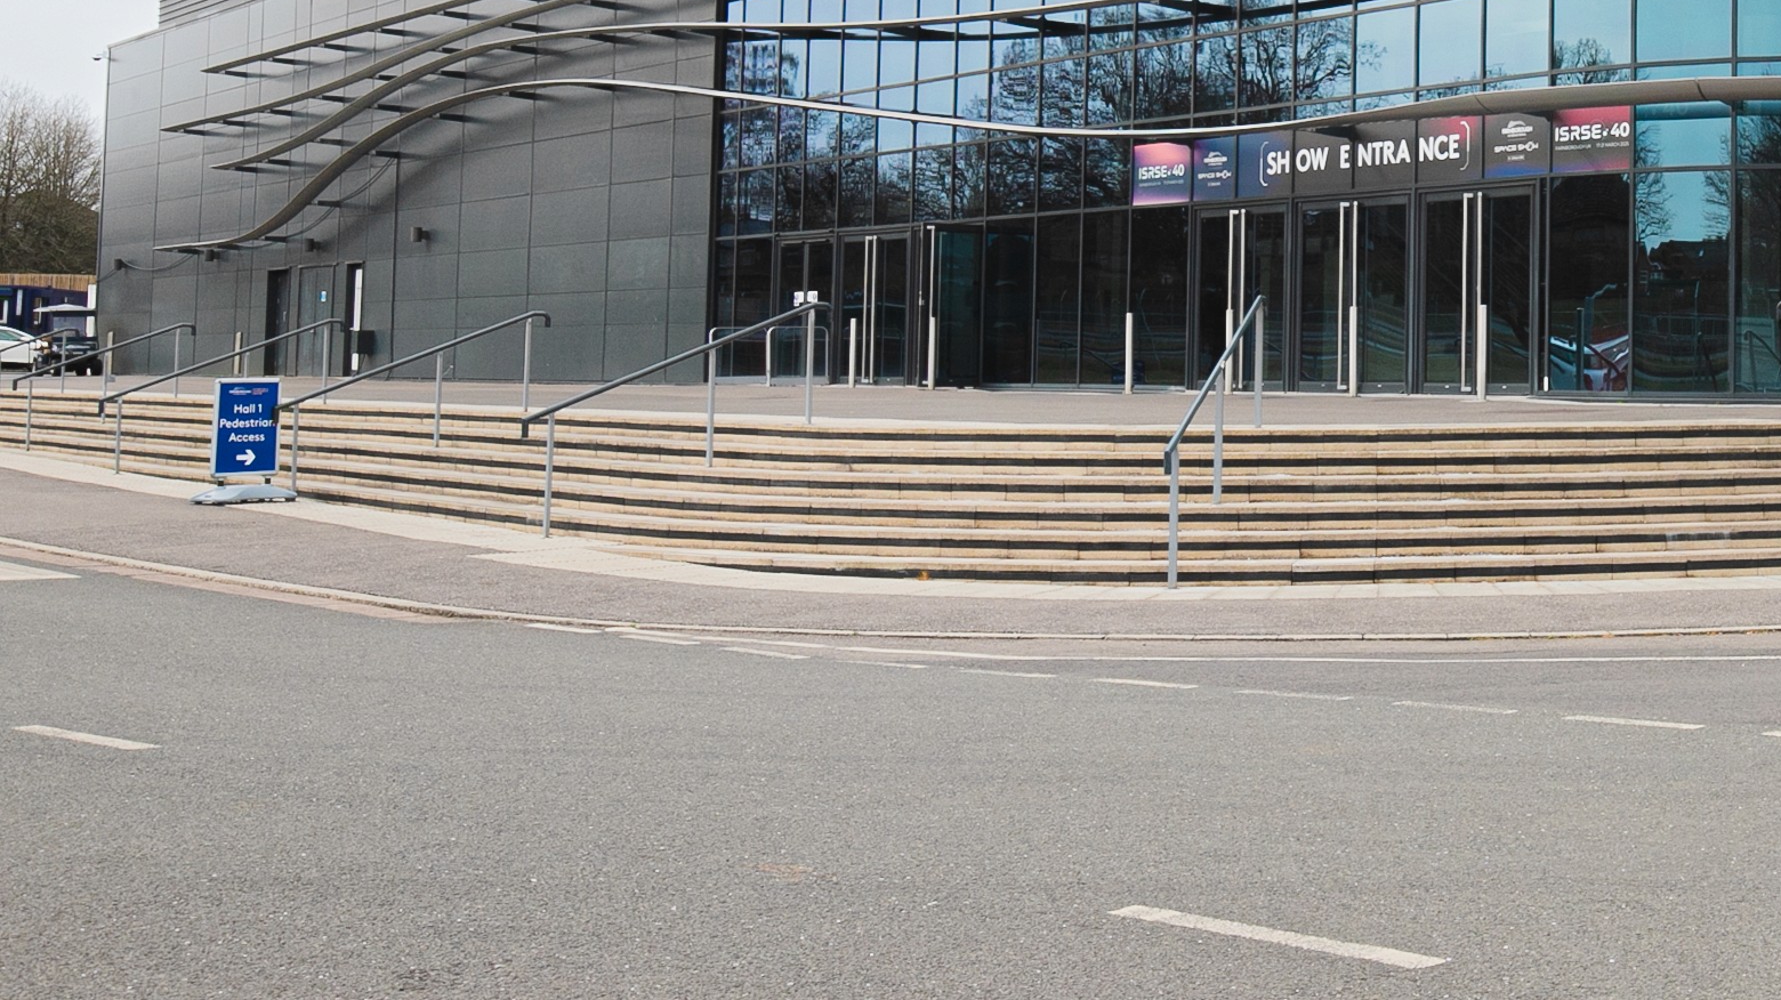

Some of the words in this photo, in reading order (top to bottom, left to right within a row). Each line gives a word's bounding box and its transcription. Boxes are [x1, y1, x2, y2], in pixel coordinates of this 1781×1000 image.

[1266, 146, 1329, 175] SHOW
[1339, 134, 1461, 169] ENTRANCE
[233, 404, 256, 414] Hall
[258, 403, 263, 413] 1
[228, 432, 265, 443] Access
